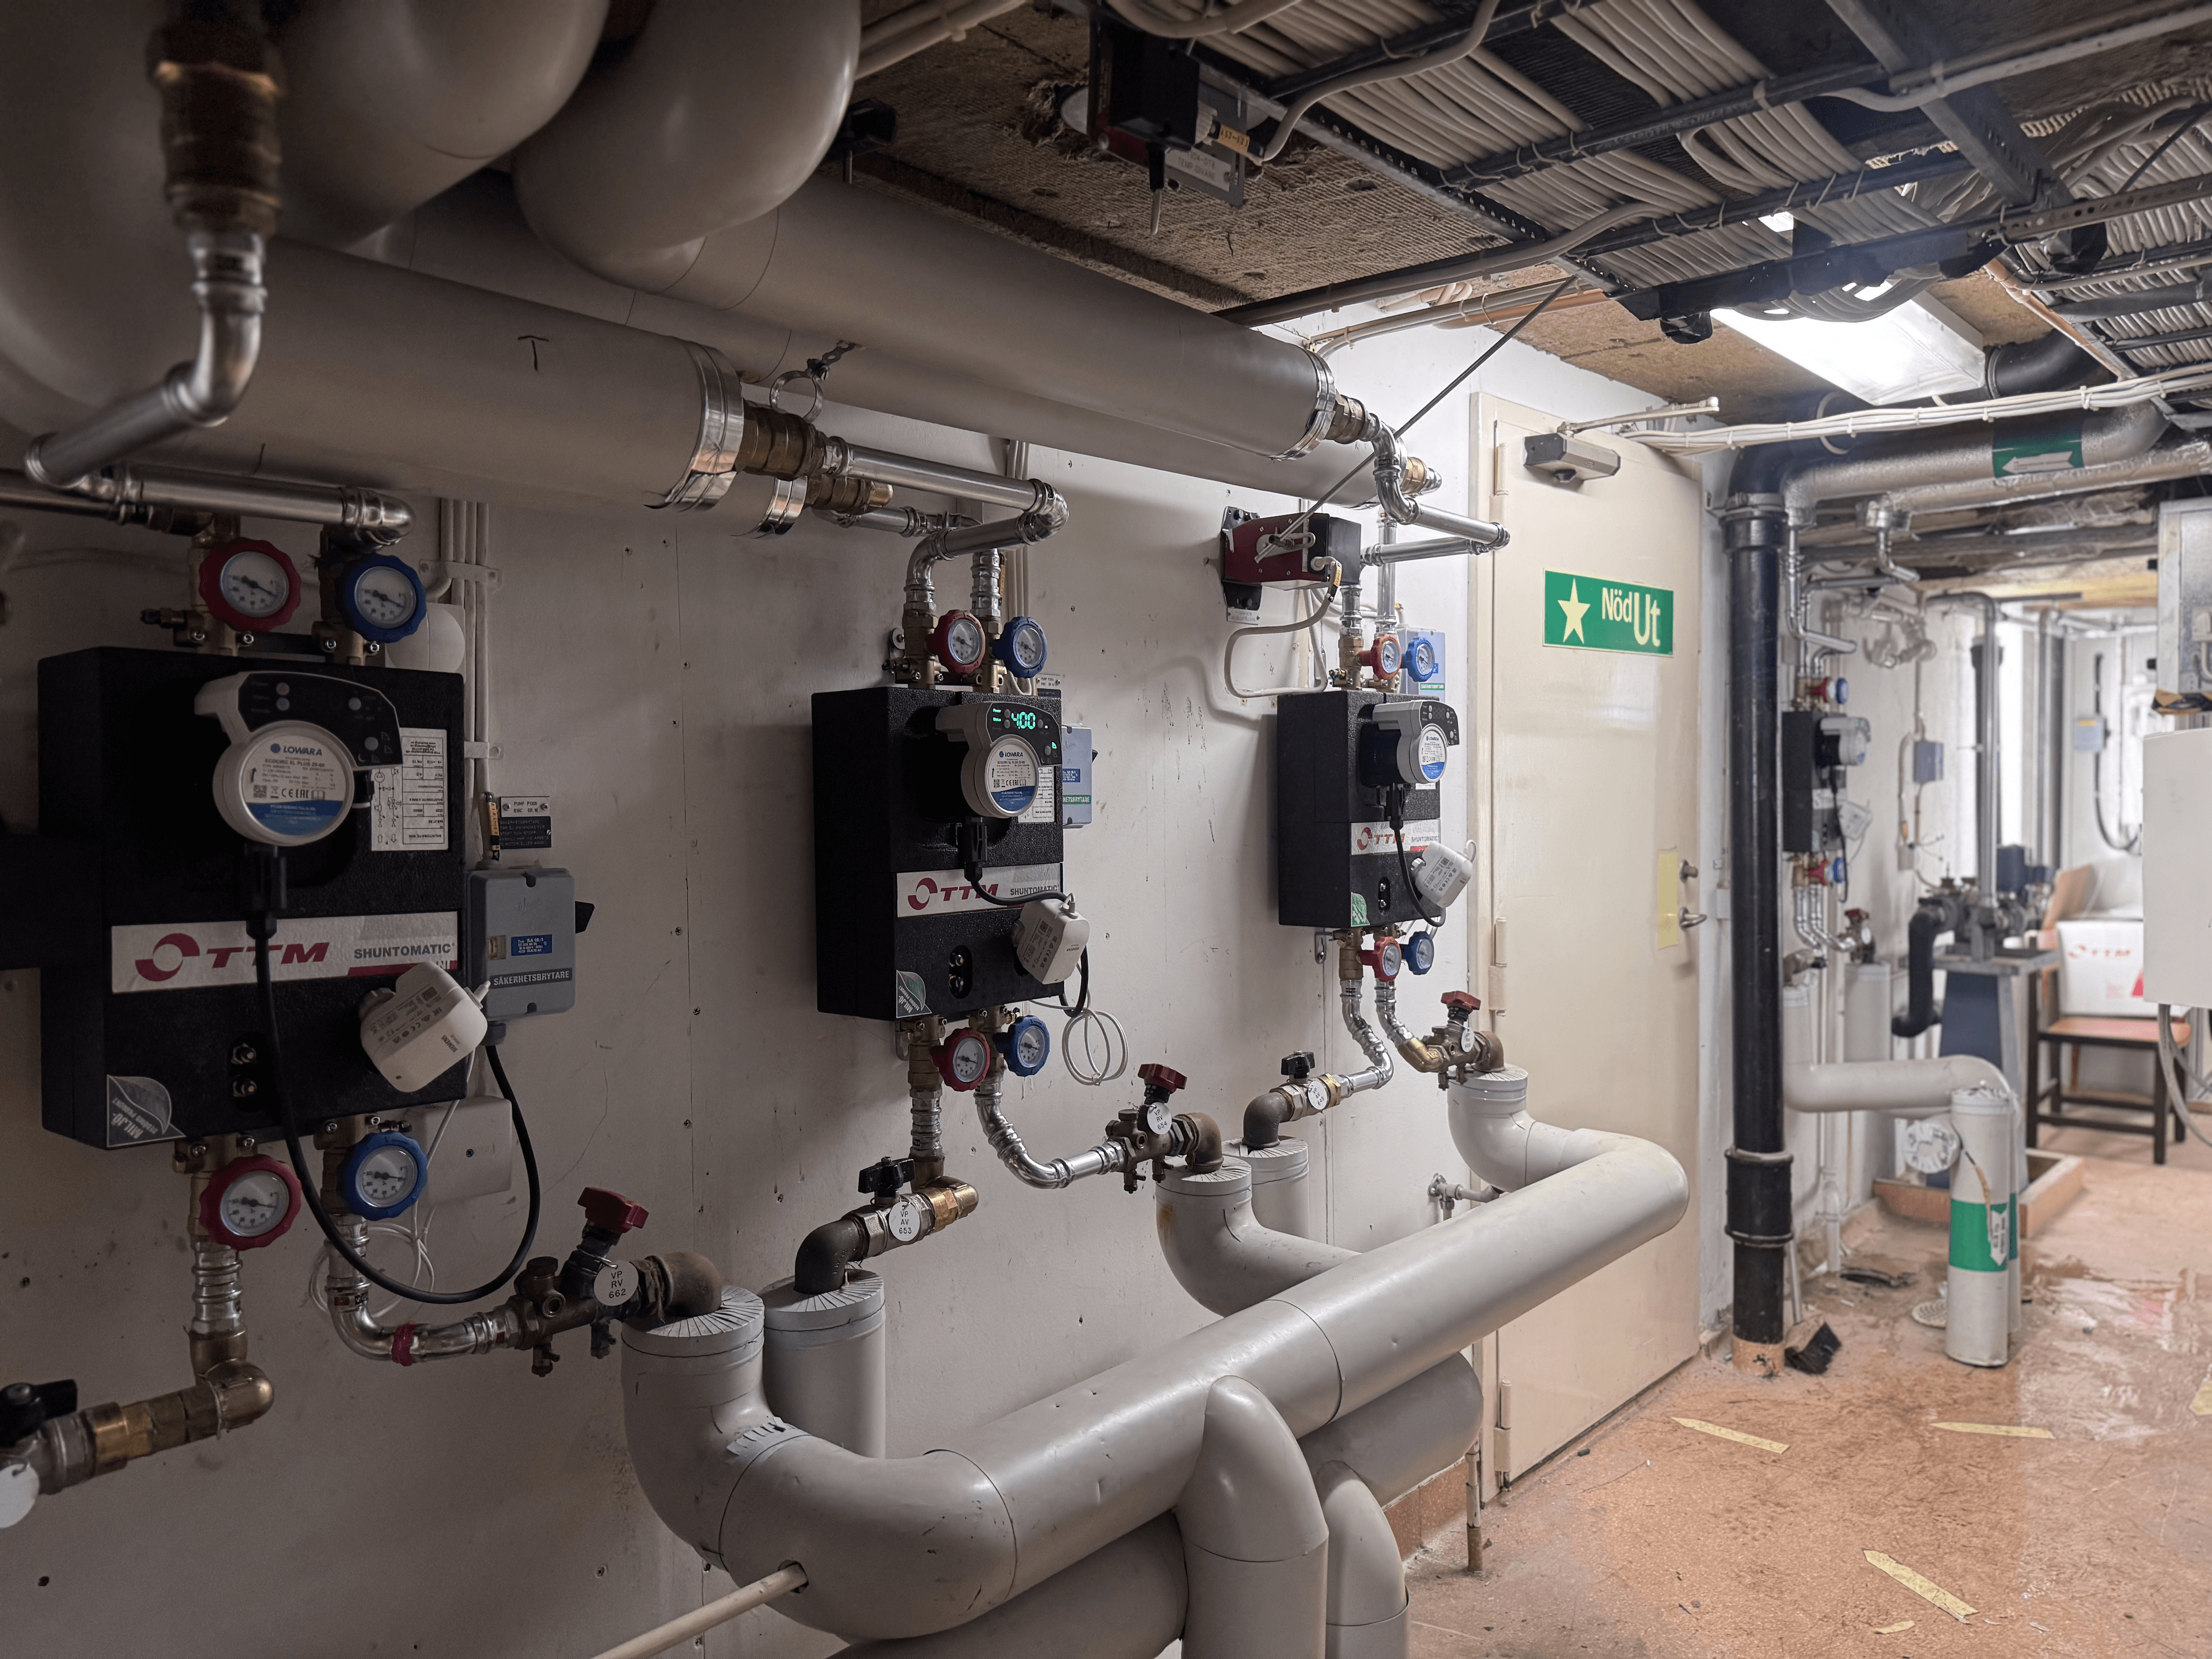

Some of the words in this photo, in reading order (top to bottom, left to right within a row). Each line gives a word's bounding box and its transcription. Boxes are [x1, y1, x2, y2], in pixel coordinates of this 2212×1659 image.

[1602, 587, 1633, 623] Nöd
[1634, 592, 1661, 647] Ut
[283, 746, 323, 756] LOWARA
[940, 883, 999, 902] TTM
[354, 943, 451, 959] SHUNTOMATIC
[494, 971, 570, 986] SÄKERHETSBRYTARE
[1157, 1121, 1168, 1130] 654
[611, 1271, 623, 1279] VP
[611, 1279, 623, 1288] RV
[609, 1289, 626, 1298] 662
